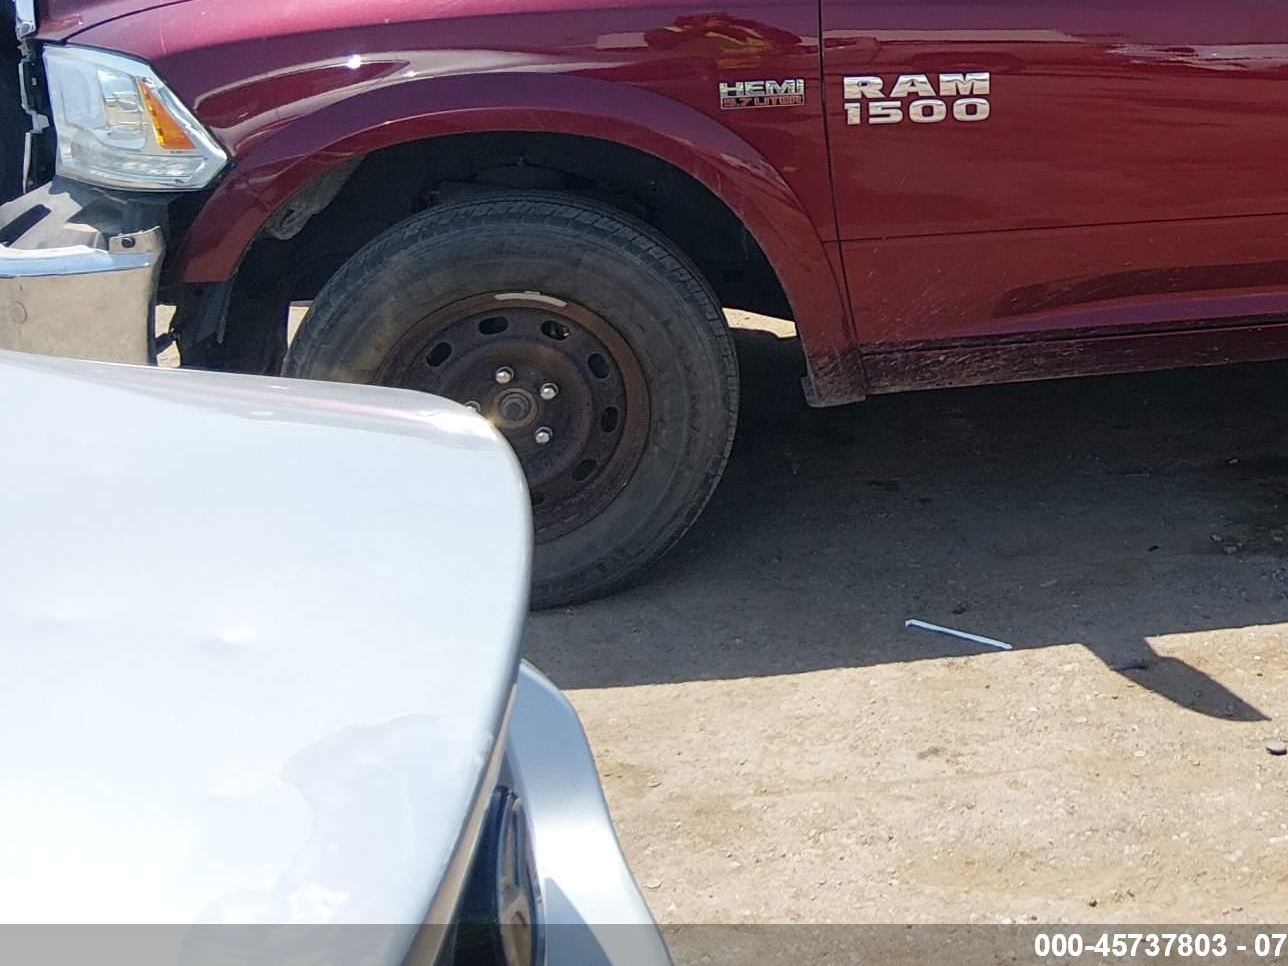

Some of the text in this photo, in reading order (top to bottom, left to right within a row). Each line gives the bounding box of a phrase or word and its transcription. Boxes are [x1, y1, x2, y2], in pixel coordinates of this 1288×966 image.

[719, 79, 804, 97] HEMI
[843, 72, 990, 99] RAM
[754, 95, 802, 106] LITER
[844, 98, 990, 125] 1500
